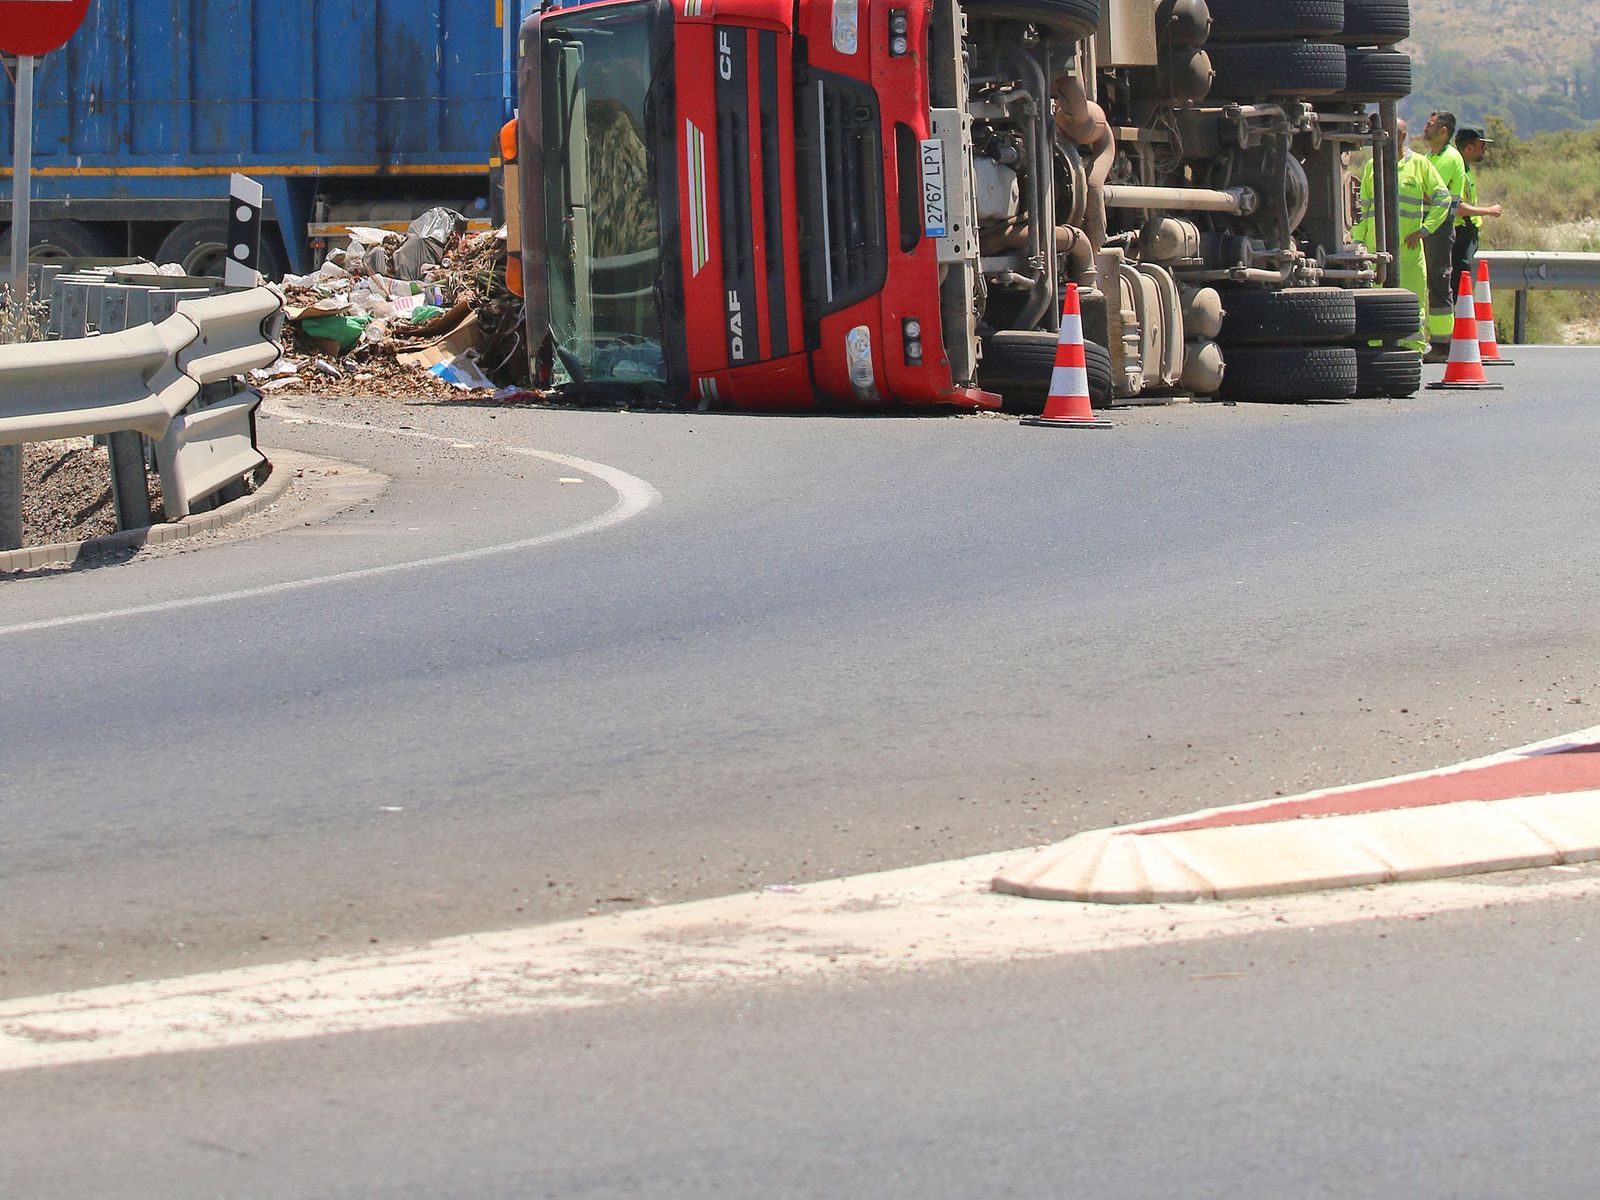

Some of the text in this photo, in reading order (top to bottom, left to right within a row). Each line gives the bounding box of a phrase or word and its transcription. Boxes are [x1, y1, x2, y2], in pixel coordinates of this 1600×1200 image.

[720, 31, 731, 80] CF
[924, 145, 940, 176] LPY
[926, 182, 943, 223] 2767
[728, 290, 743, 359] DAF
